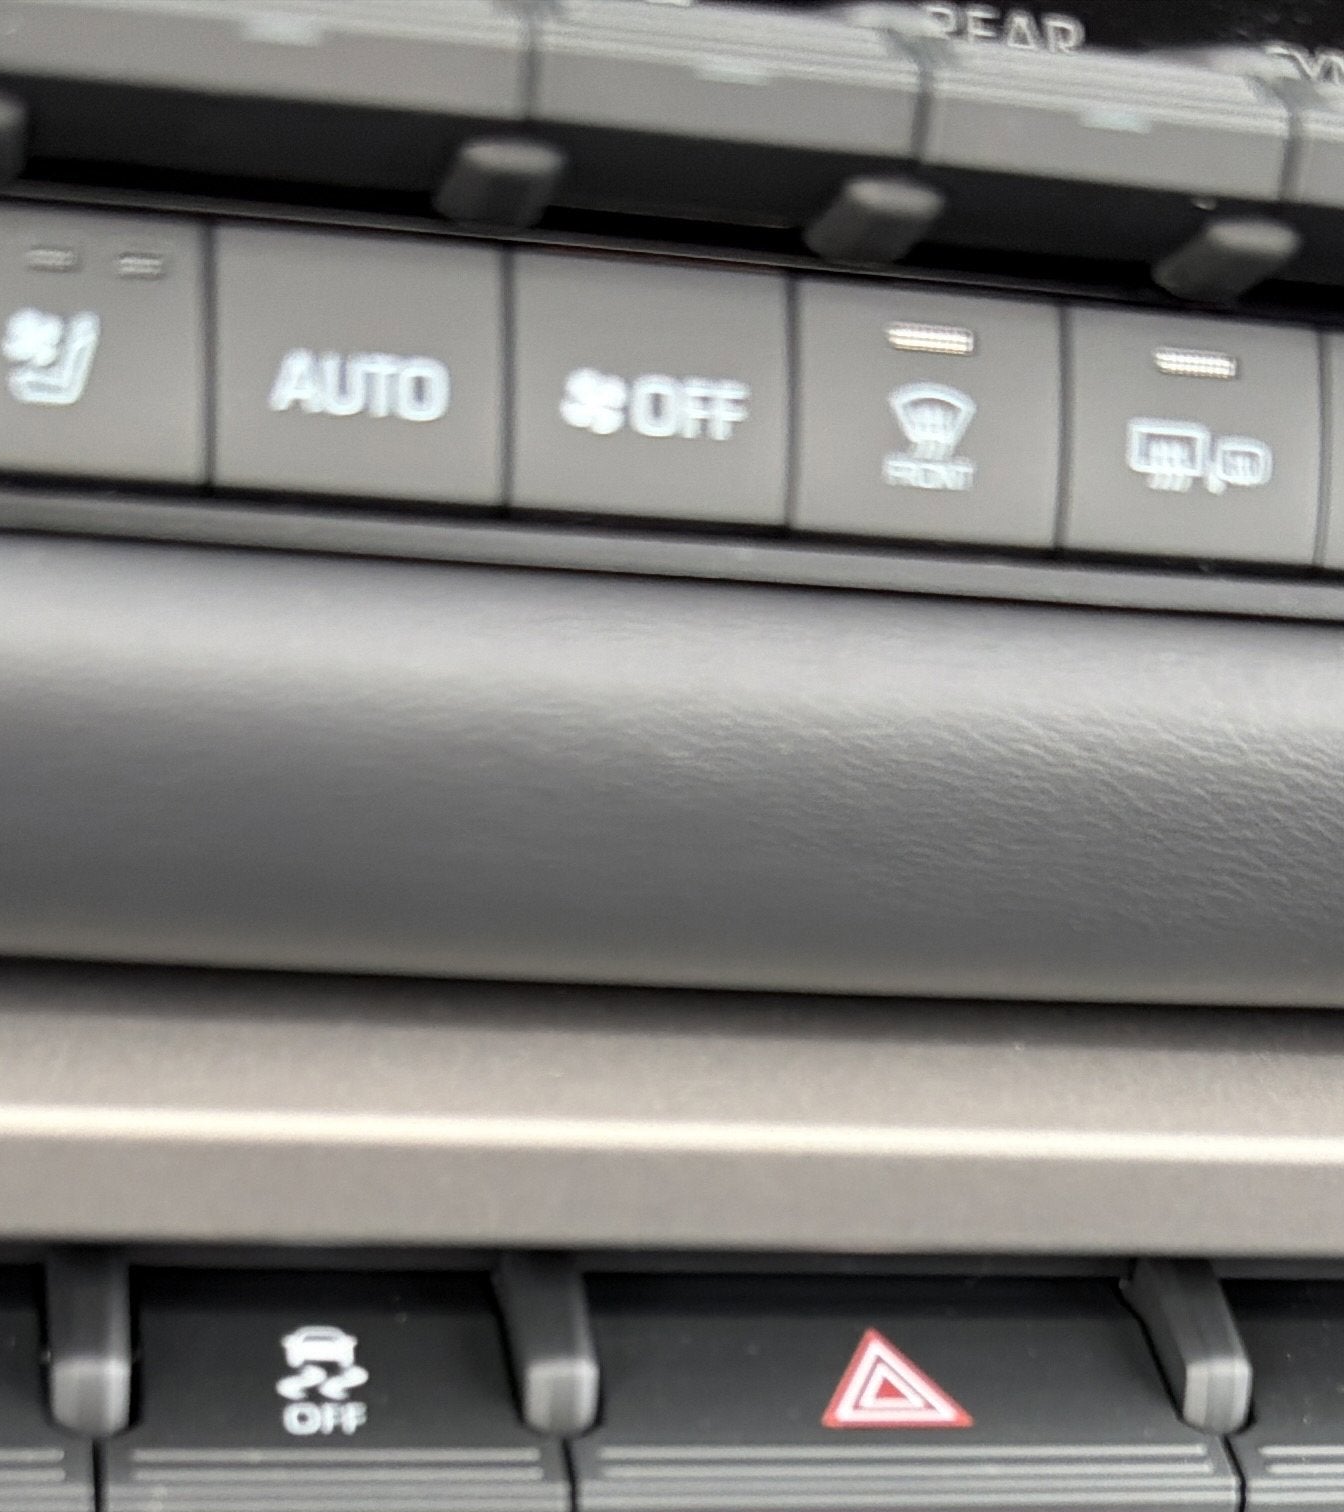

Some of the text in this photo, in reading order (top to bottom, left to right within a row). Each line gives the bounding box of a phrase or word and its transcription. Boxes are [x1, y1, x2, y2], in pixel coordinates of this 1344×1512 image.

[269, 347, 450, 422] AUTO
[627, 373, 750, 441] OFF
[282, 1400, 368, 1436] OFF
